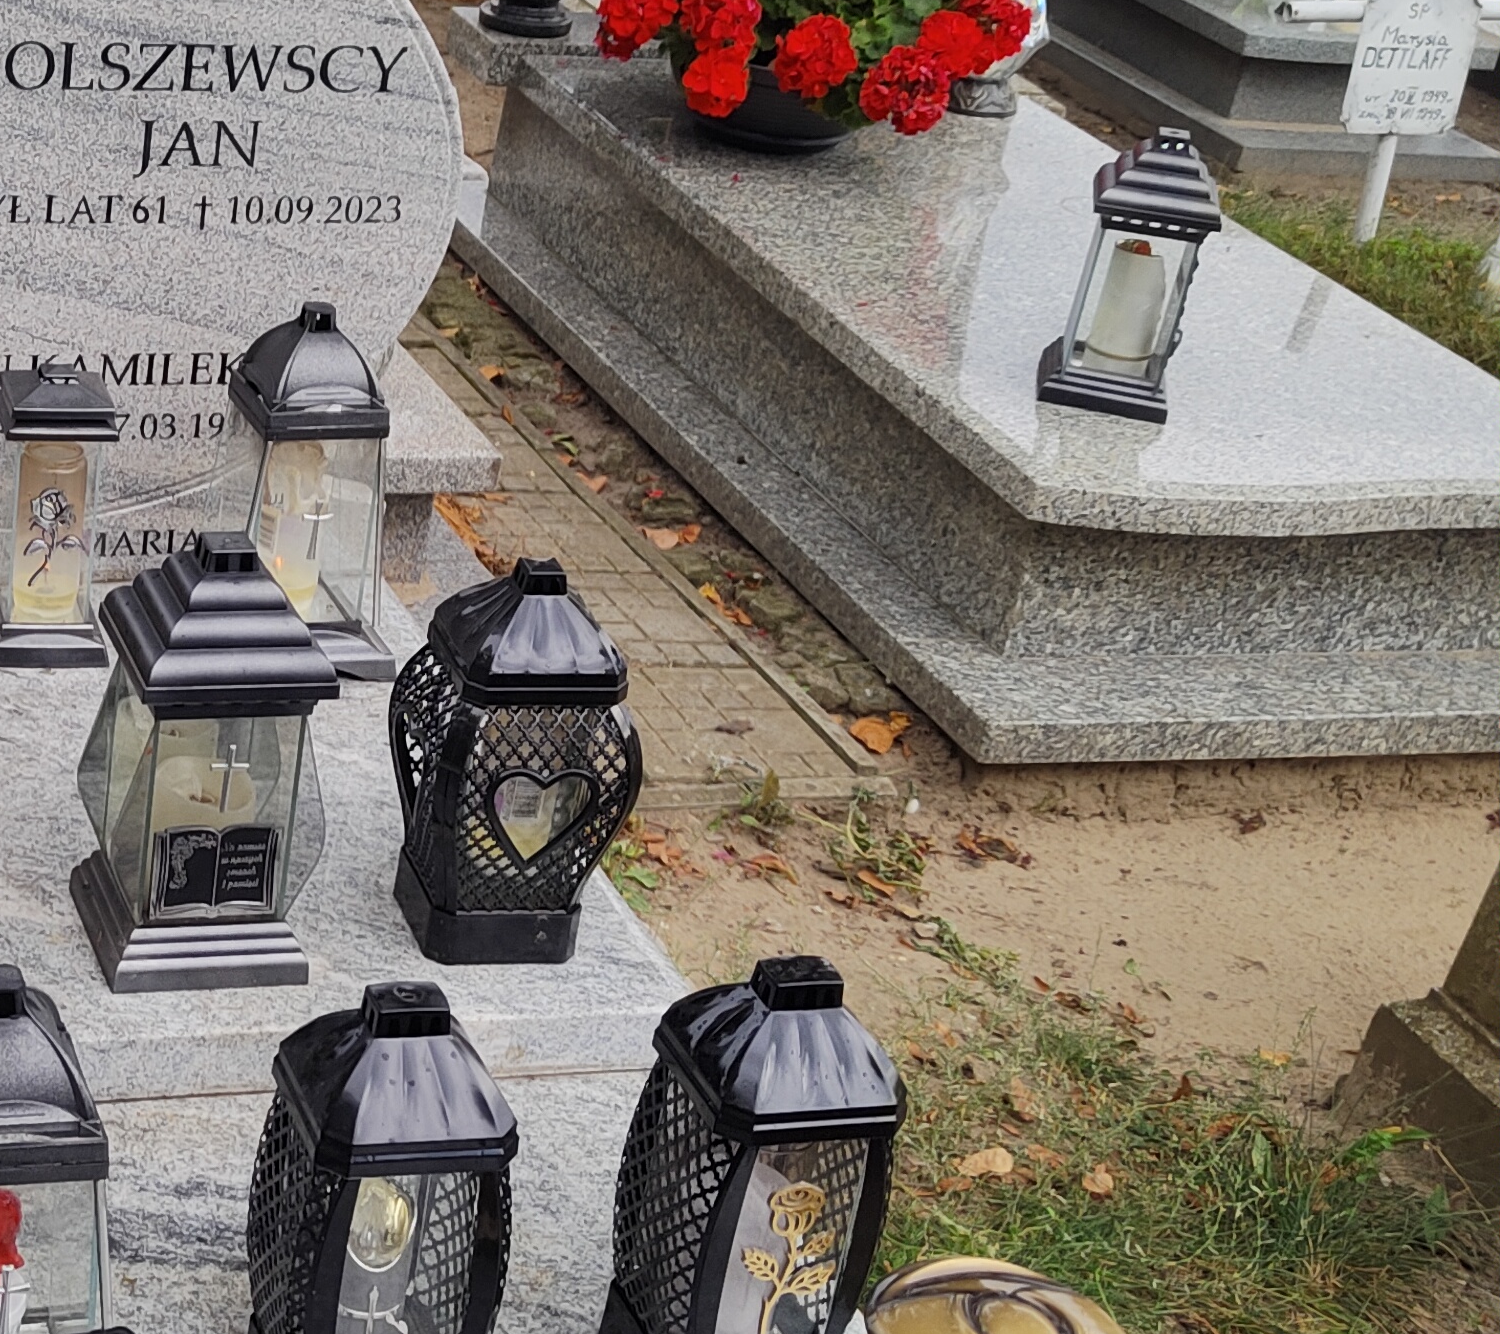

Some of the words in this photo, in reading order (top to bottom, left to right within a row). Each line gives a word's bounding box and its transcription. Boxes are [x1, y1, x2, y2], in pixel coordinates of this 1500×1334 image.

[1381, 25, 1449, 49] Marysia
[3, 38, 409, 96] OLSZEWSCY
[1361, 46, 1454, 71] DETTLAFF
[132, 119, 263, 179] JAN
[43, 192, 125, 225] LAT
[131, 194, 169, 226] 61
[227, 193, 403, 227] 10.09.2023
